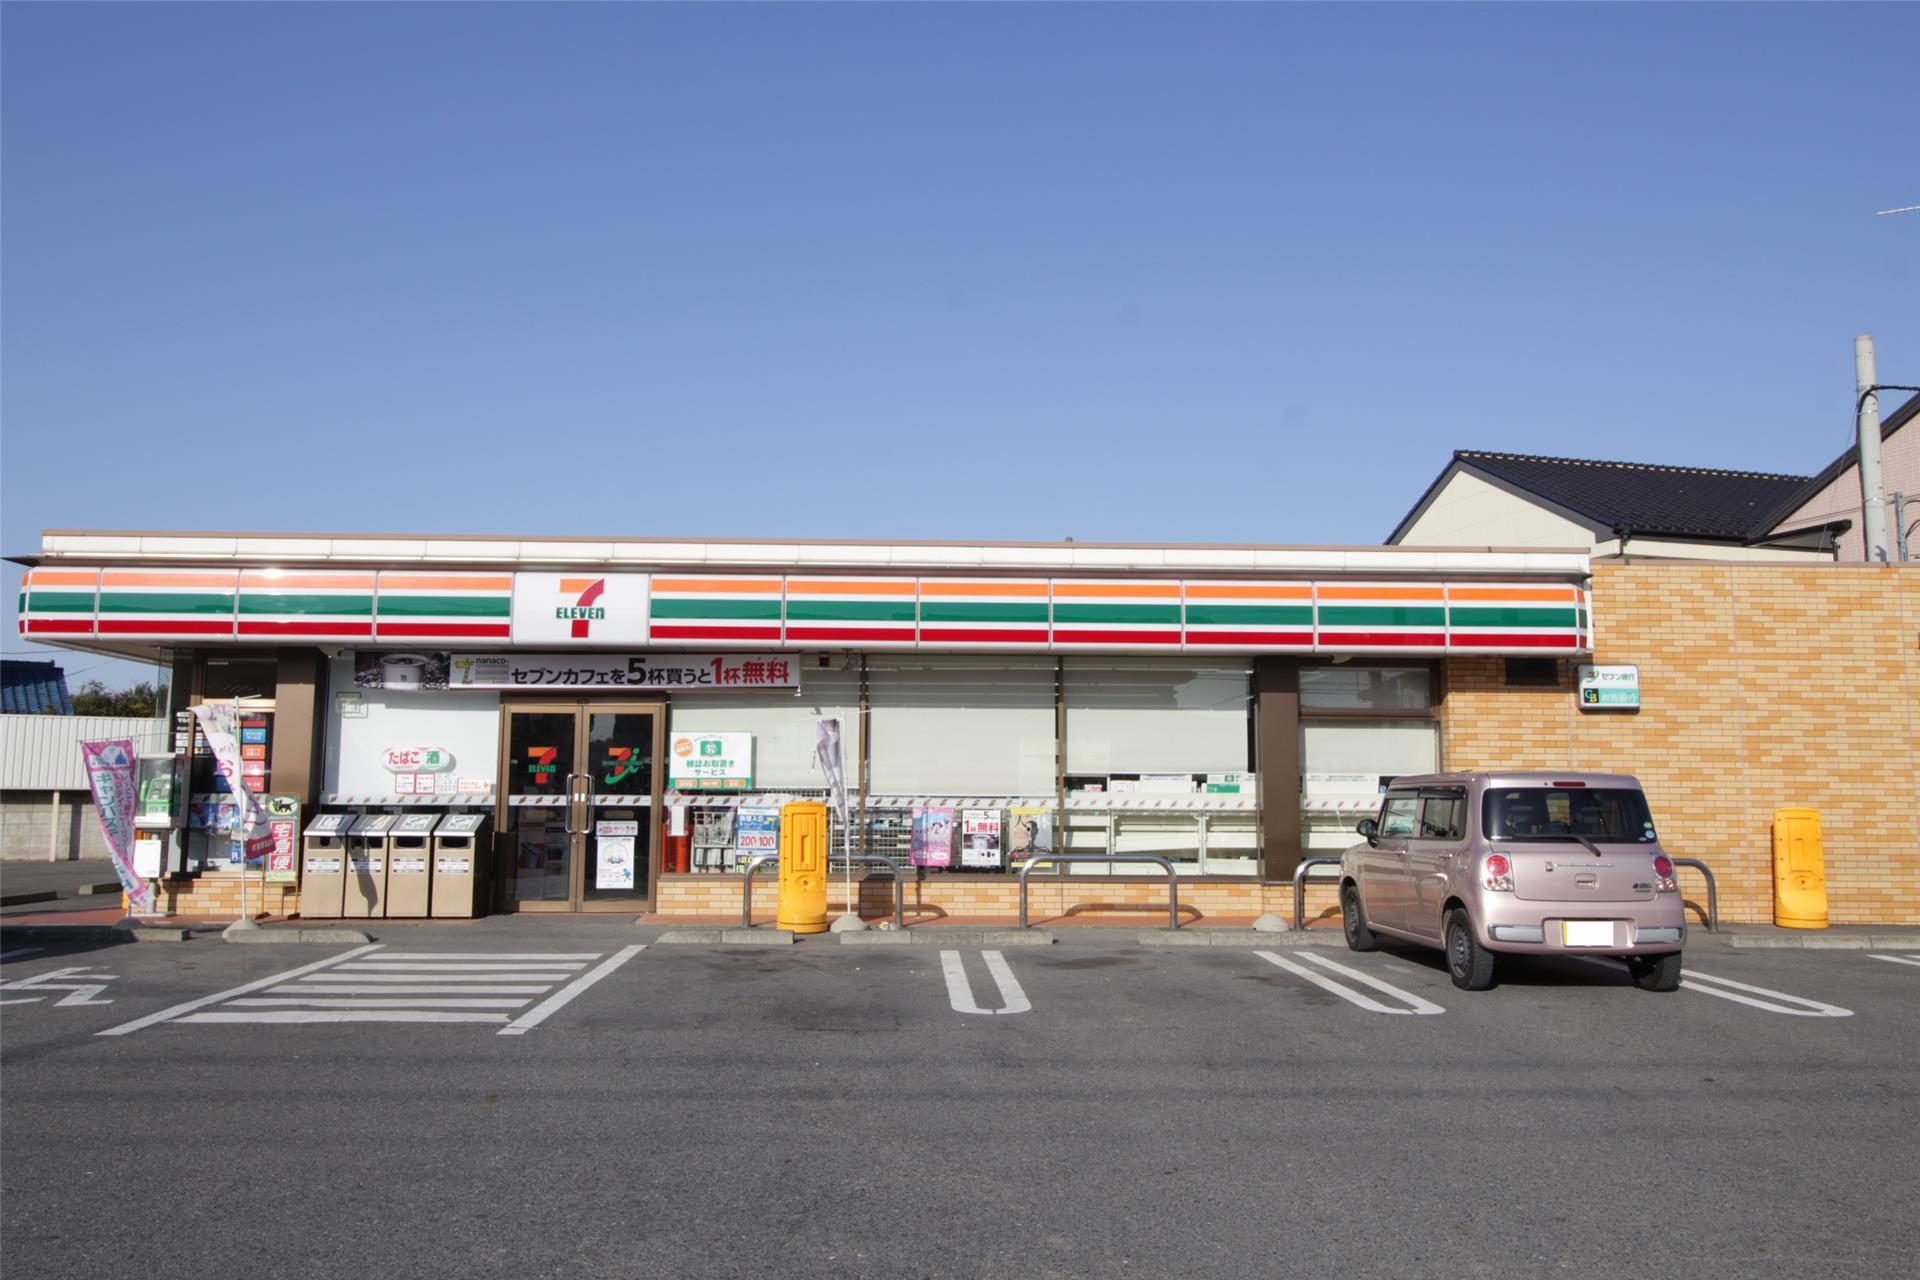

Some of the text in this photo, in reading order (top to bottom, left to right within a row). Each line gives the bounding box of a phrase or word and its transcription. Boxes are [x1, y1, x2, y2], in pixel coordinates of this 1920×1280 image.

[388, 751, 440, 765] たばこ 酒
[271, 822, 291, 870] 宅急便
